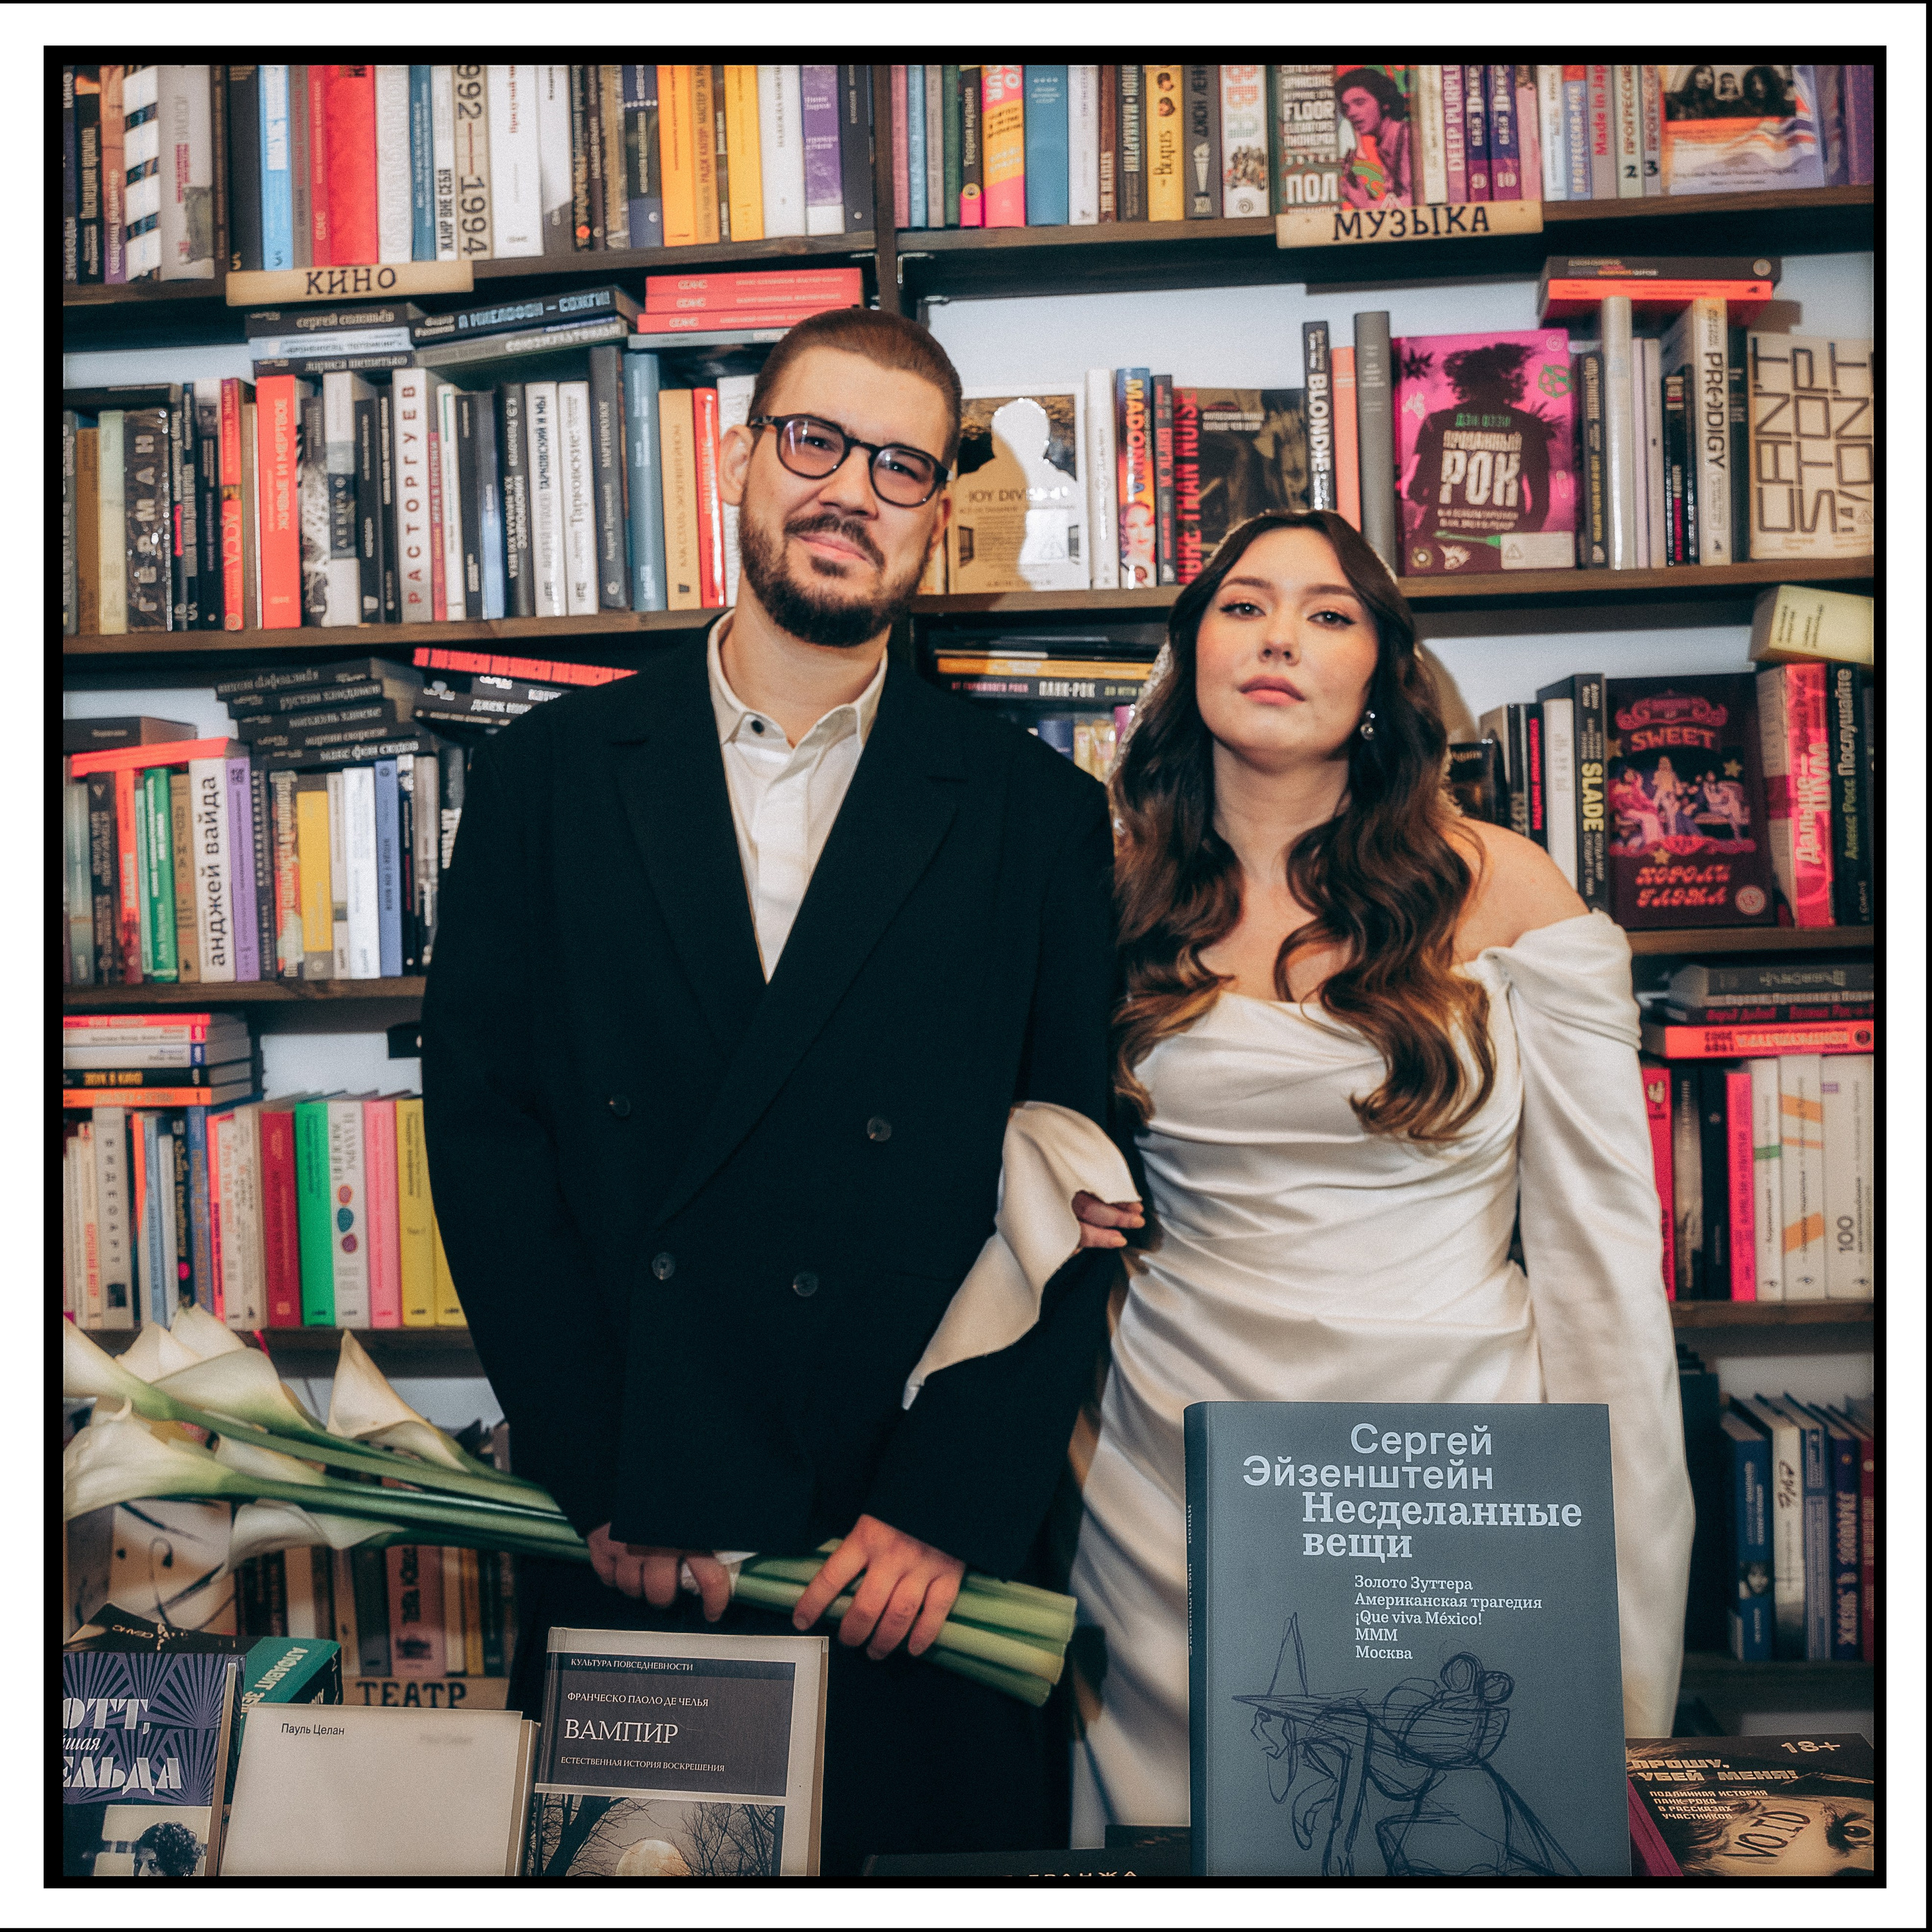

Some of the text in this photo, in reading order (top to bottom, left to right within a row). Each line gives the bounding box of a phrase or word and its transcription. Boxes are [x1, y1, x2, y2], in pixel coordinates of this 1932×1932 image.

[1284, 102, 1335, 120] FLOOR
[1592, 92, 1605, 109] in
[1593, 111, 1607, 156] Made
[1447, 127, 1464, 171] DEEP
[1623, 165, 1638, 179] 2
[1644, 160, 1658, 177] 3
[1286, 172, 1339, 204] ПОЛ
[460, 176, 488, 255] 1994
[1333, 205, 1491, 241] МУЗЫКА
[305, 267, 397, 295] КИНО
[1173, 389, 1198, 457] NOISE
[1307, 374, 1331, 472] BLONDIE
[1443, 429, 1523, 452] ПРОДАННЫЙ
[1174, 463, 1201, 520] THAN
[1438, 448, 1521, 507] РОК
[401, 384, 423, 605] РАСТОРГУЕВ
[134, 434, 158, 612] ГЕРМАН
[1039, 681, 1096, 697] ПАНК-РОК
[1835, 667, 1858, 776] Послушайте
[320, 740, 419, 761] макс фон сюдов
[1630, 726, 1716, 752] SWEET
[1581, 762, 1604, 832] SLADE
[198, 775, 227, 967] анджей вайда
[1836, 1214, 1855, 1253] 100
[1350, 1423, 1492, 1463] Сергей
[1243, 1454, 1493, 1491] Эйзенштейн
[1302, 1491, 1582, 1530] Несделанные
[1303, 1533, 1413, 1563] вещи
[1355, 1574, 1473, 1592] Золото Зуттера
[1355, 1593, 1543, 1611] Американская трагедия
[1355, 1611, 1482, 1628] ¡Que viva México!
[1355, 1628, 1398, 1641] МММ
[571, 1657, 694, 1671] КУЛЬТУРА ПОВСЕДНЕВНОСТИ
[1355, 1646, 1413, 1660] Москва
[355, 1680, 467, 1709] ТЕАТР
[567, 1691, 709, 1708] ФРАНЧЕСКО ПАОЛО ДЕ ЧЕЛЬЯ
[281, 1722, 346, 1737] Пауль Целан
[564, 1718, 679, 1745] ВАМПИР
[1781, 1740, 1841, 1754] 18+
[561, 1756, 725, 1772] ЕСТЕСТВЕННАЯ ИСТОРИЯ ВОСКРЕШЕНИЯ
[1632, 1758, 1730, 1769] ПРОШУ,
[1637, 1770, 1799, 1782] УБЕЙ МЕНЯ!
[1723, 1810, 1812, 1858] VOID
